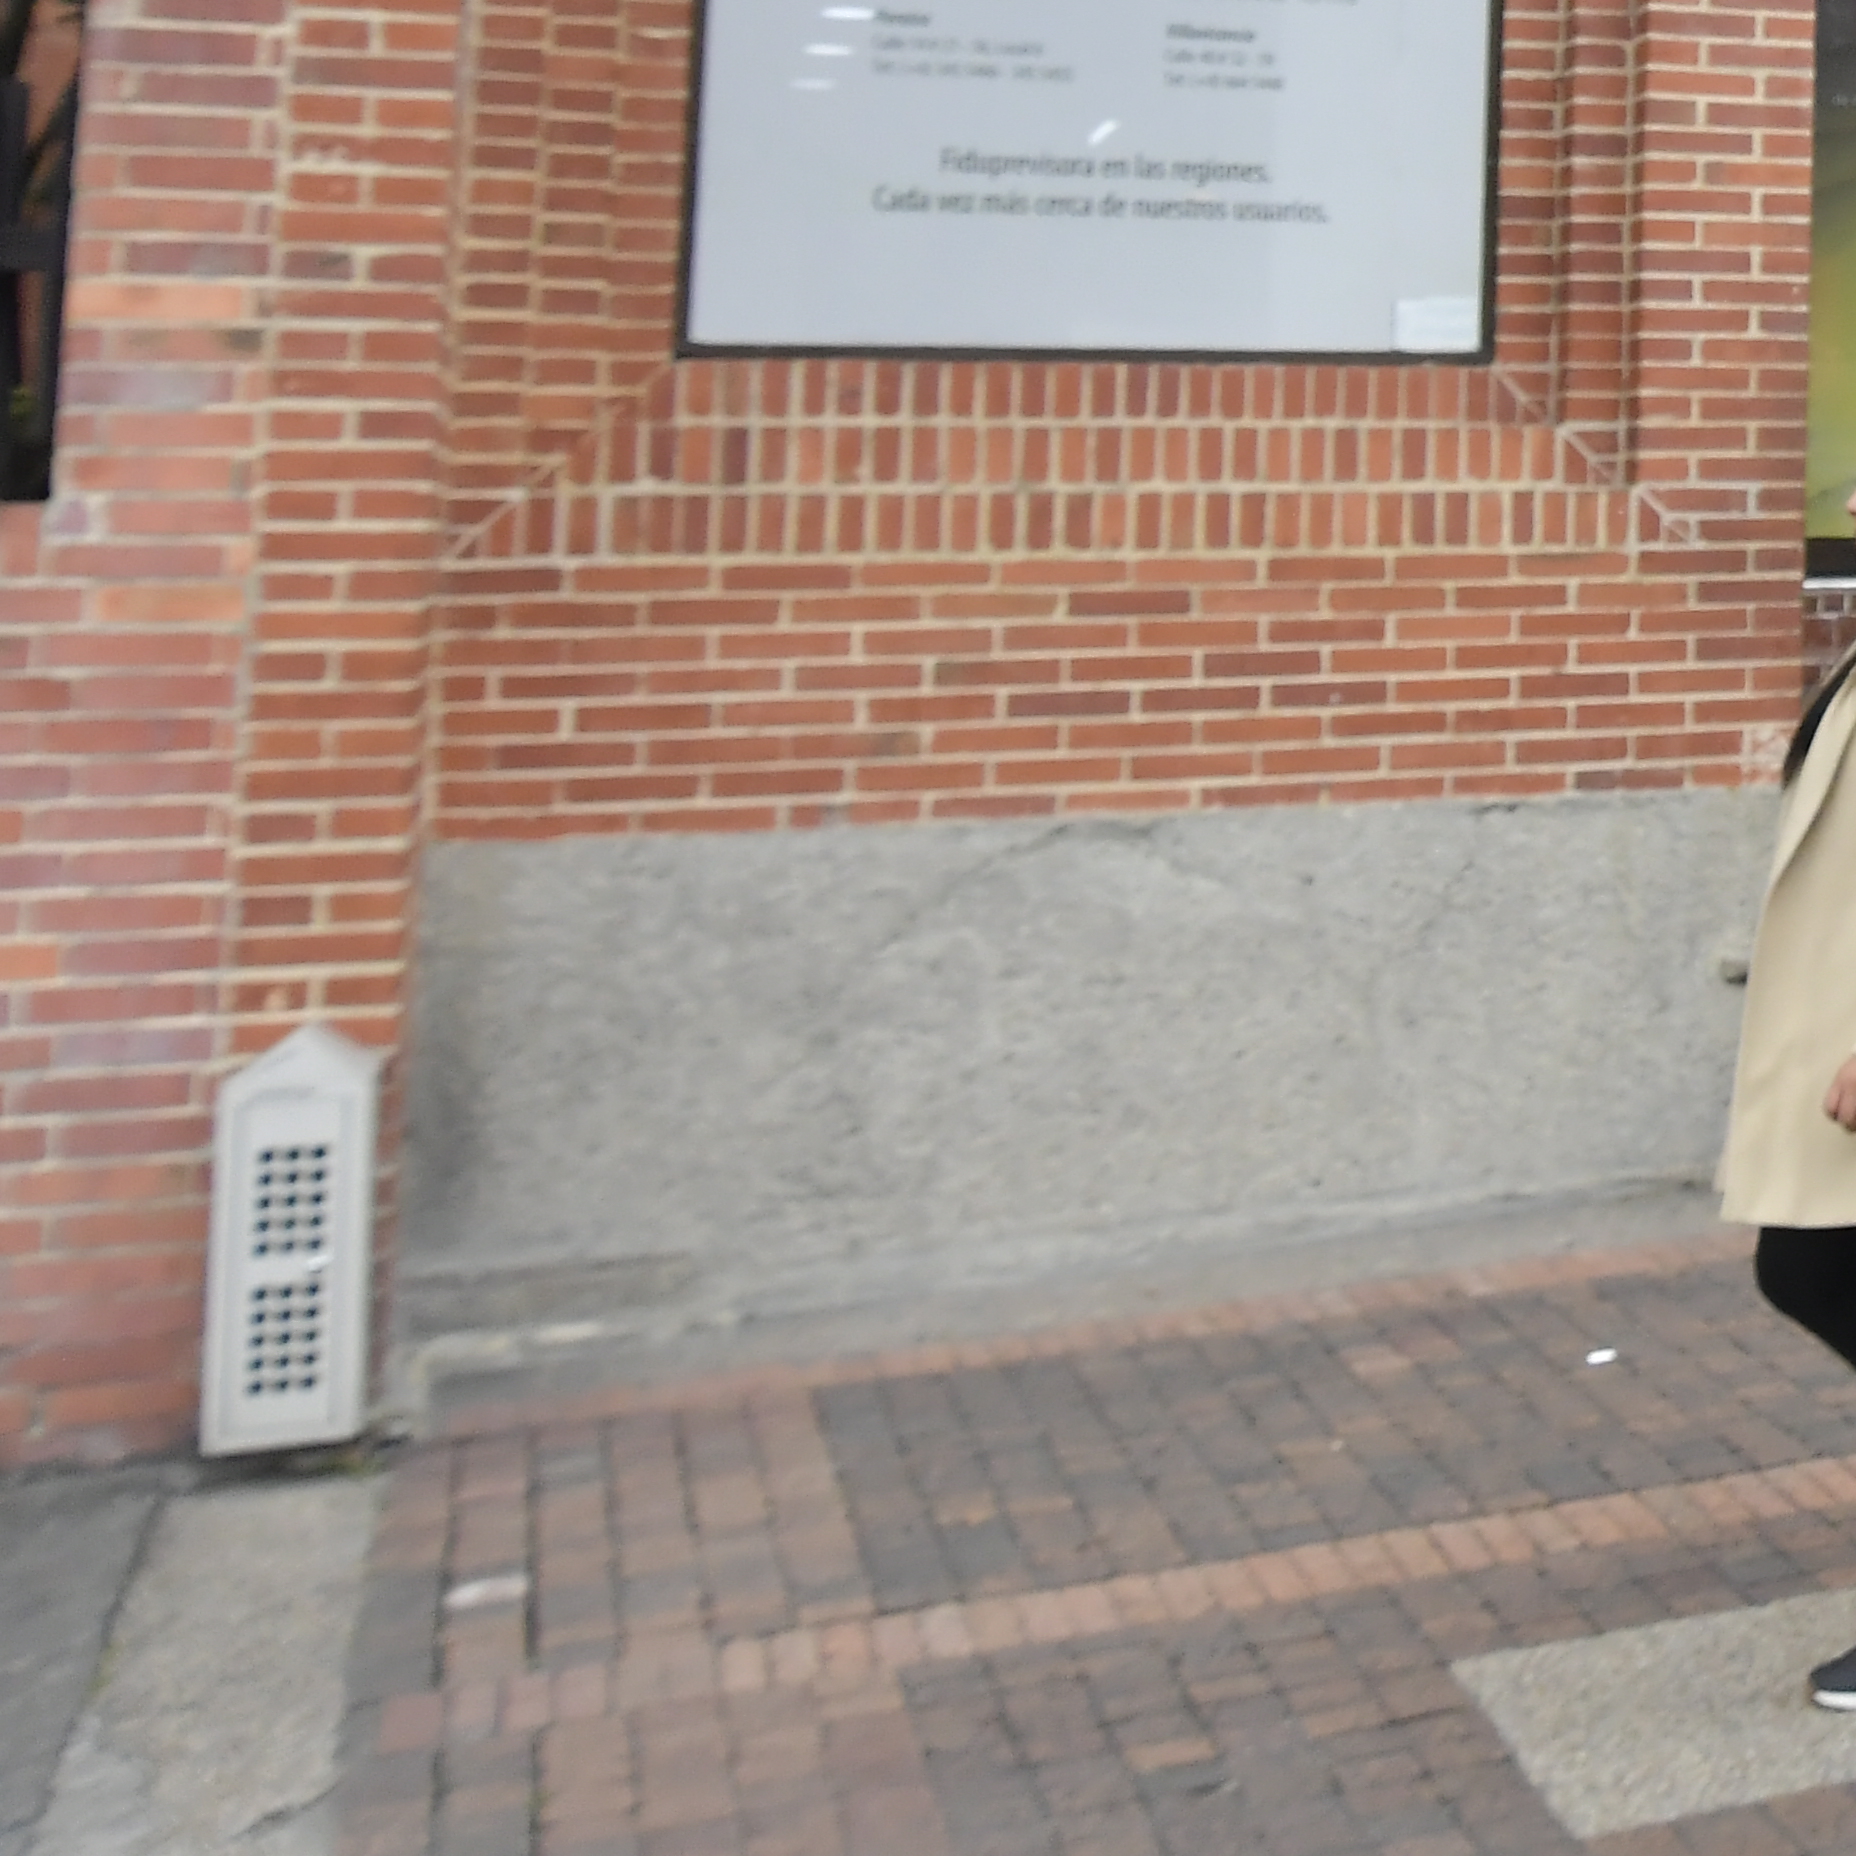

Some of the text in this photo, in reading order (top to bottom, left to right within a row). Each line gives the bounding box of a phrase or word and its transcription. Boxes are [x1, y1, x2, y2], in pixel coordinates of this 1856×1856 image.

[940, 145, 1096, 178] Fiduprevisora
[1101, 158, 1129, 180] en
[1133, 150, 1166, 181] las
[872, 184, 931, 213] Cada
[1036, 195, 1096, 219] cerca
[1100, 189, 1129, 219] de
[1133, 197, 1228, 222] nuestros
